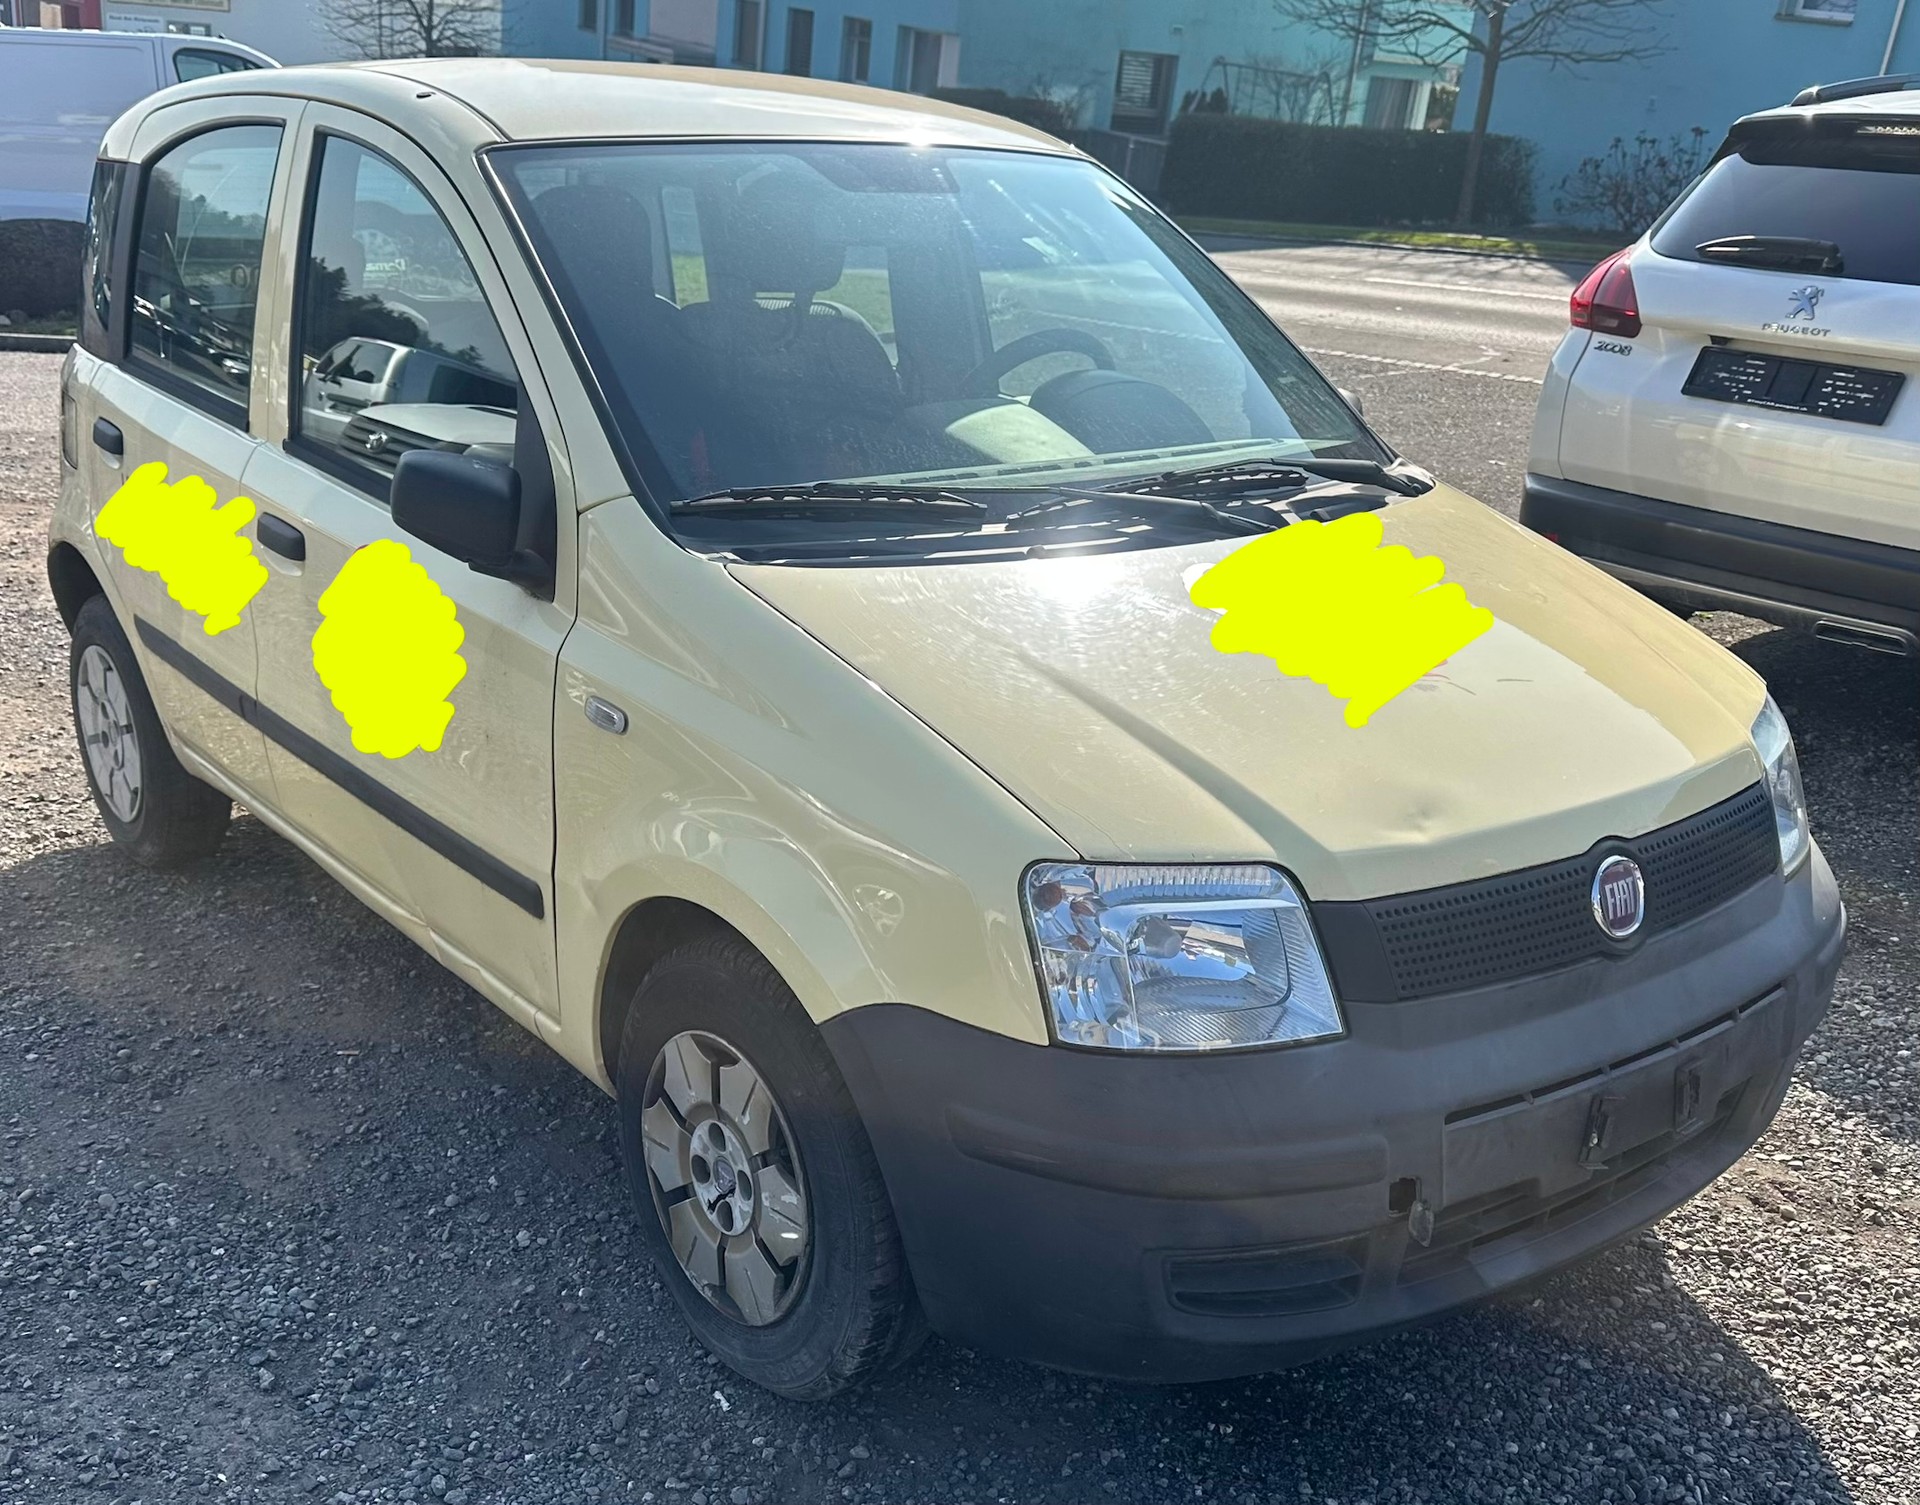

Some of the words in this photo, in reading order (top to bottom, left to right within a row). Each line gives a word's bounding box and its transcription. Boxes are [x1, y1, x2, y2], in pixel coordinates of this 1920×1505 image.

[1761, 322, 1831, 337] PEUGEOT
[1593, 340, 1633, 357] 2008
[1604, 876, 1635, 920] FIAT
